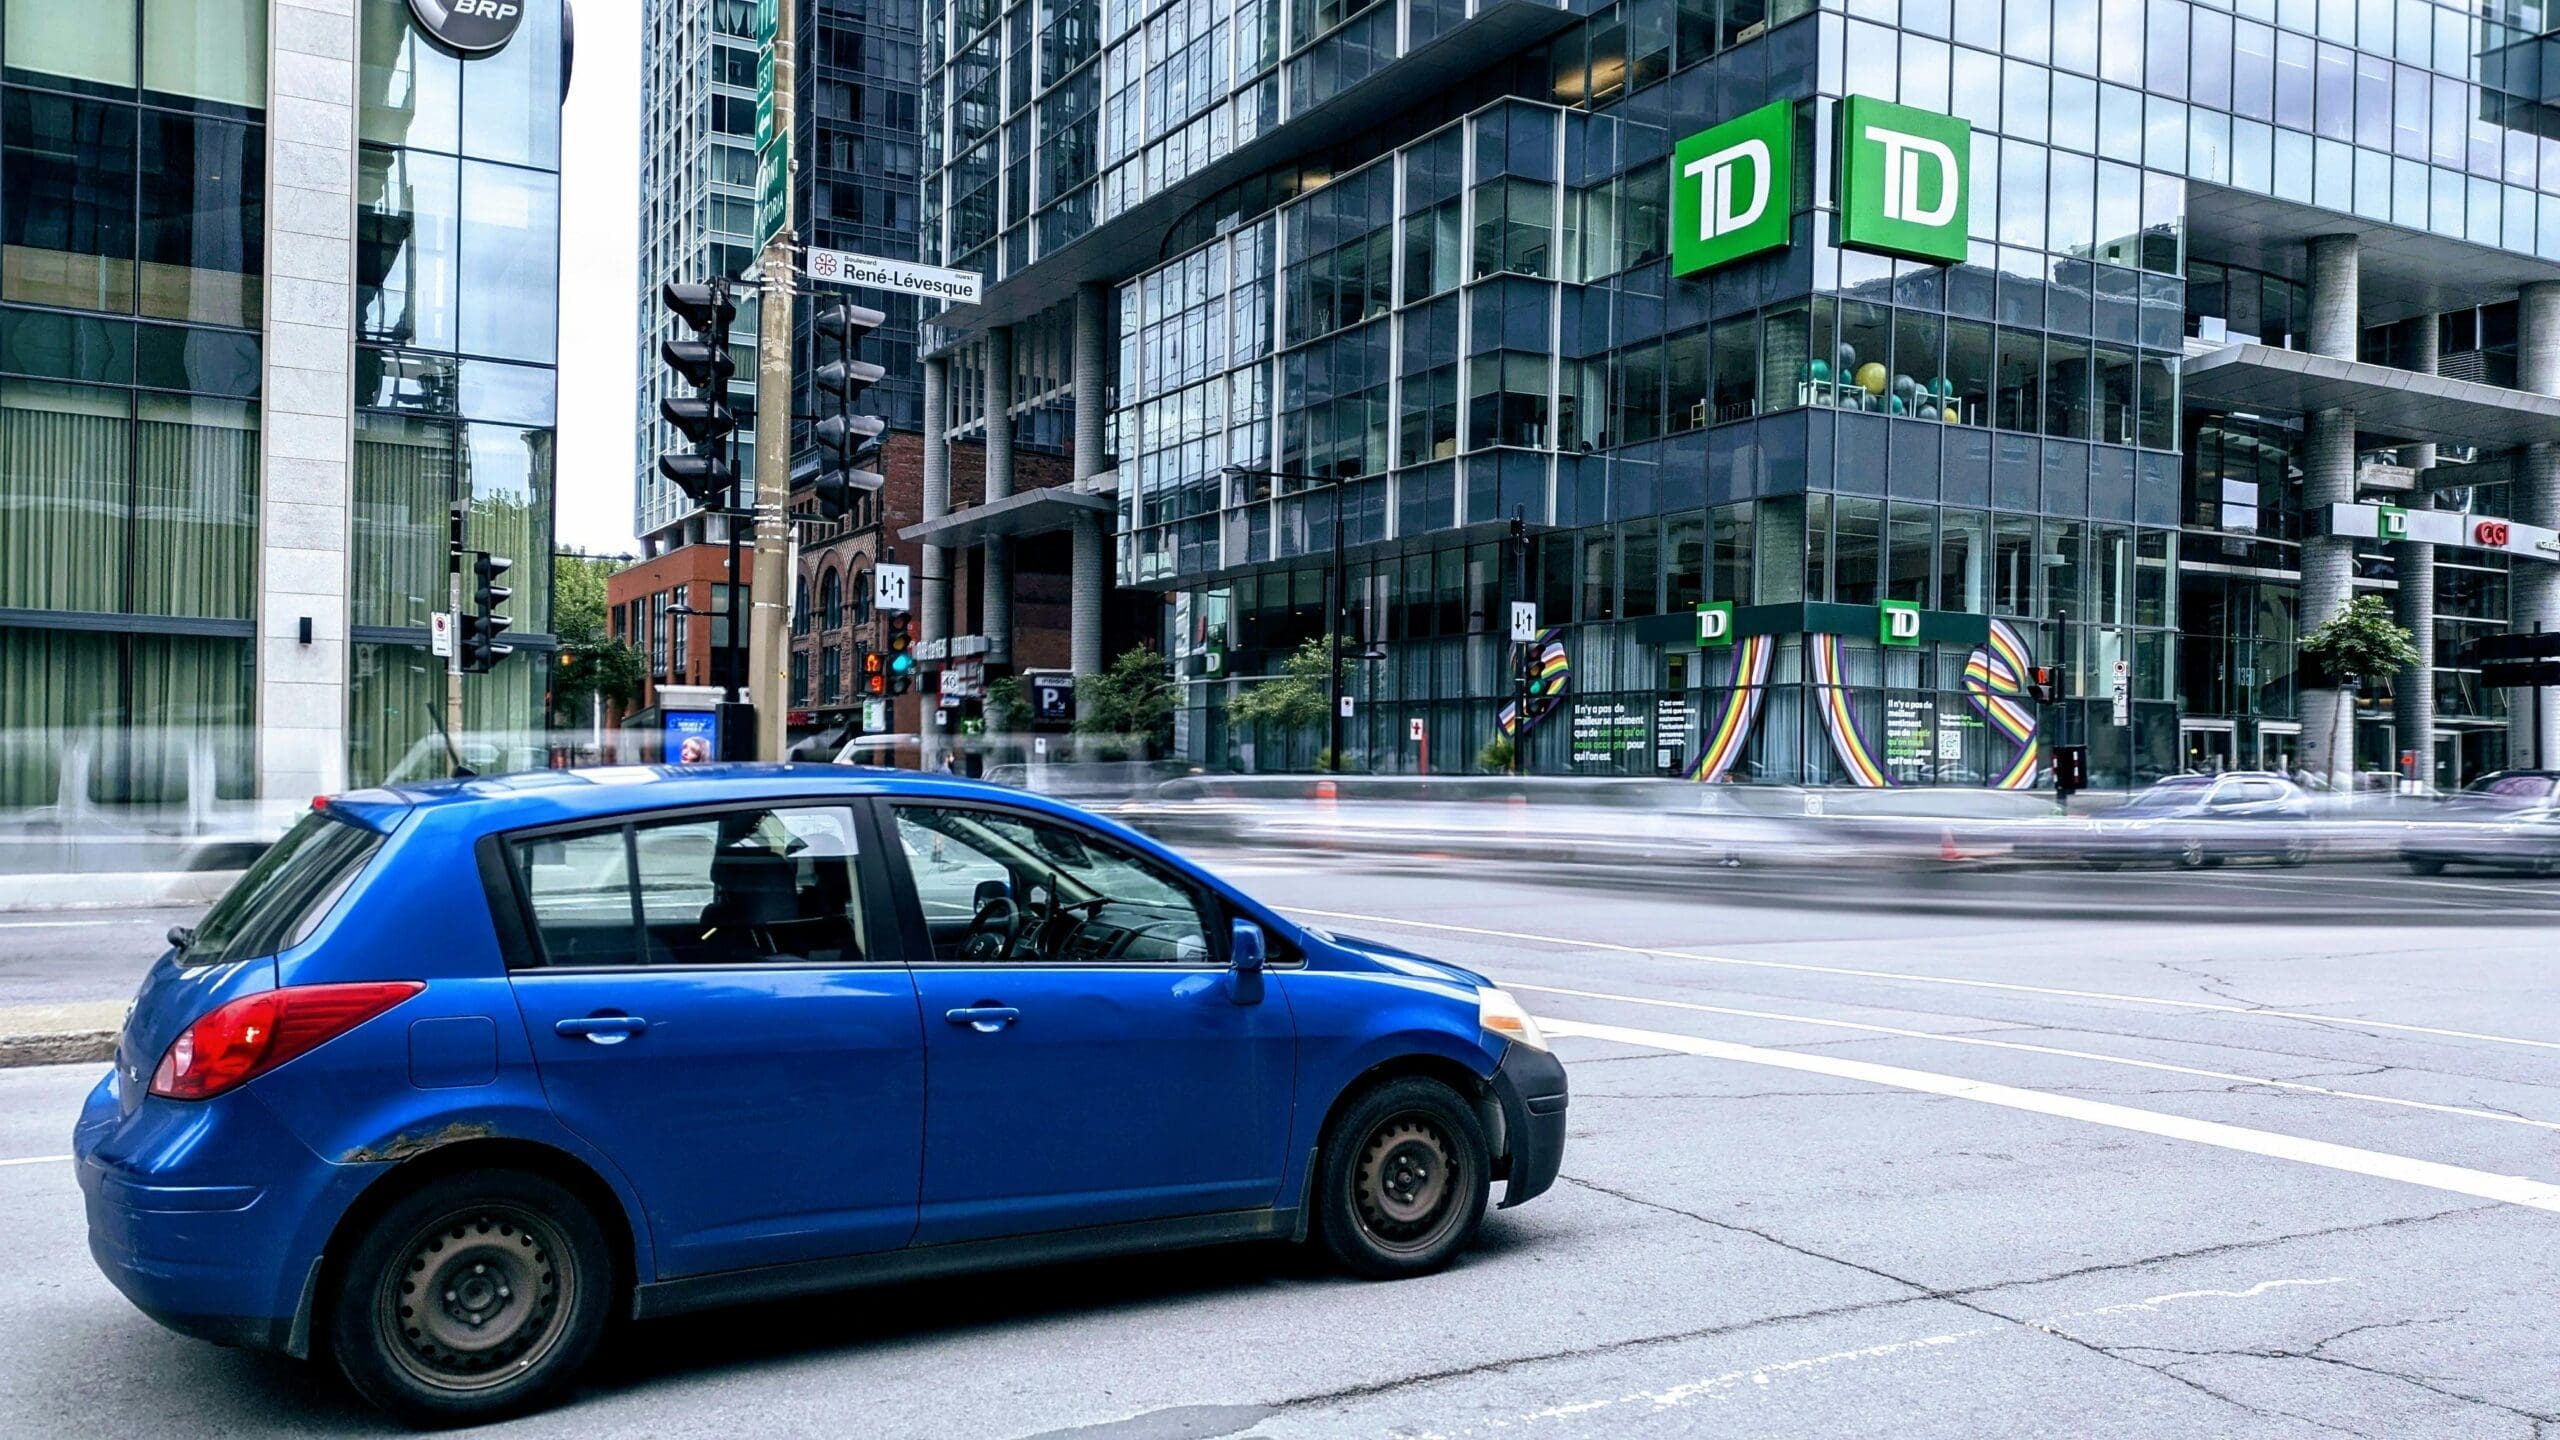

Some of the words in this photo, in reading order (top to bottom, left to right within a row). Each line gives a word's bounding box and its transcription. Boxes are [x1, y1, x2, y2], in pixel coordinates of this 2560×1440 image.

[454, 0, 518, 20] BRP
[759, 60, 771, 93] EST
[1865, 125, 1959, 227] TD
[1684, 139, 1771, 242] TD
[844, 256, 878, 266] Boulevard
[843, 264, 973, 297] René-Lévesque
[2384, 512, 2407, 533] TD
[1696, 609, 1727, 638] TD
[1886, 607, 1920, 637] TD
[1042, 688, 1059, 709] P
[1574, 704, 1580, 714] Il
[1581, 704, 1592, 715] n'y
[1598, 705, 1612, 715] pas
[1614, 703, 1624, 713] de
[1888, 699, 1893, 708] Il
[1894, 700, 1904, 709] n'y
[1911, 702, 1923, 710] pas
[1923, 701, 1933, 709] de
[1888, 709, 1916, 718] meilleur
[1574, 716, 1602, 725] meilleur
[1888, 719, 1922, 728] sentiment
[1574, 729, 1588, 739] que
[1588, 728, 1598, 737] de
[1623, 728, 1645, 738] qu'on
[1888, 730, 1901, 738] que
[1901, 728, 1911, 737] de
[1574, 741, 1592, 749] nous
[1626, 741, 1645, 750] pour
[1574, 751, 1585, 762] qui
[1585, 751, 1598, 761] l'on
[1598, 752, 1612, 761] est.
[1915, 749, 1933, 758] pour
[1887, 757, 1899, 766] qui
